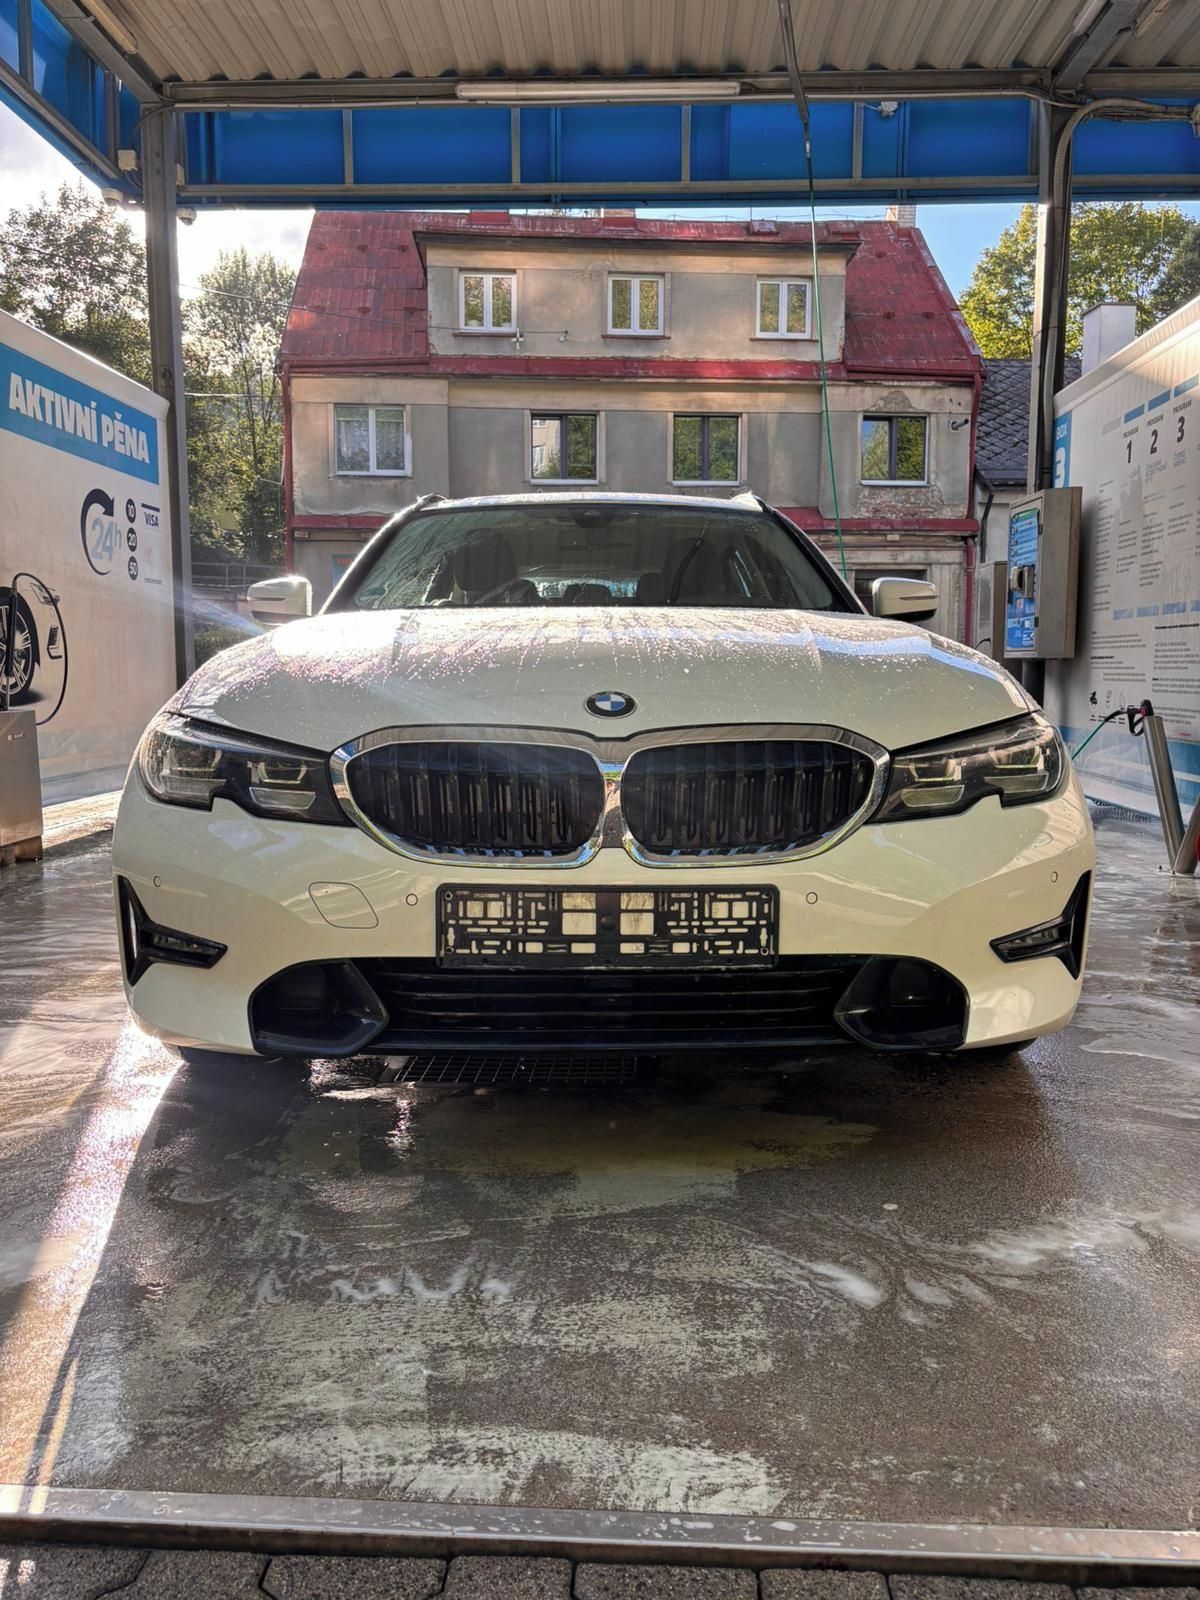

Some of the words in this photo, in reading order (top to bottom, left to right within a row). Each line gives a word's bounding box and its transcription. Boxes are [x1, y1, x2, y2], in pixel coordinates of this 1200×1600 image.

[1173, 400, 1192, 414] PROGRAM
[9, 372, 98, 444] AKTIVNÍ
[101, 411, 150, 464] PĚNA
[1056, 422, 1068, 441] BOX
[1176, 416, 1185, 443] 3
[1126, 439, 1132, 464] 1
[1150, 429, 1158, 455] 2
[128, 503, 135, 516] 10
[144, 512, 159, 528] VISA
[91, 517, 122, 562] 24h
[128, 533, 136, 547] 20
[129, 561, 137, 575] 50
